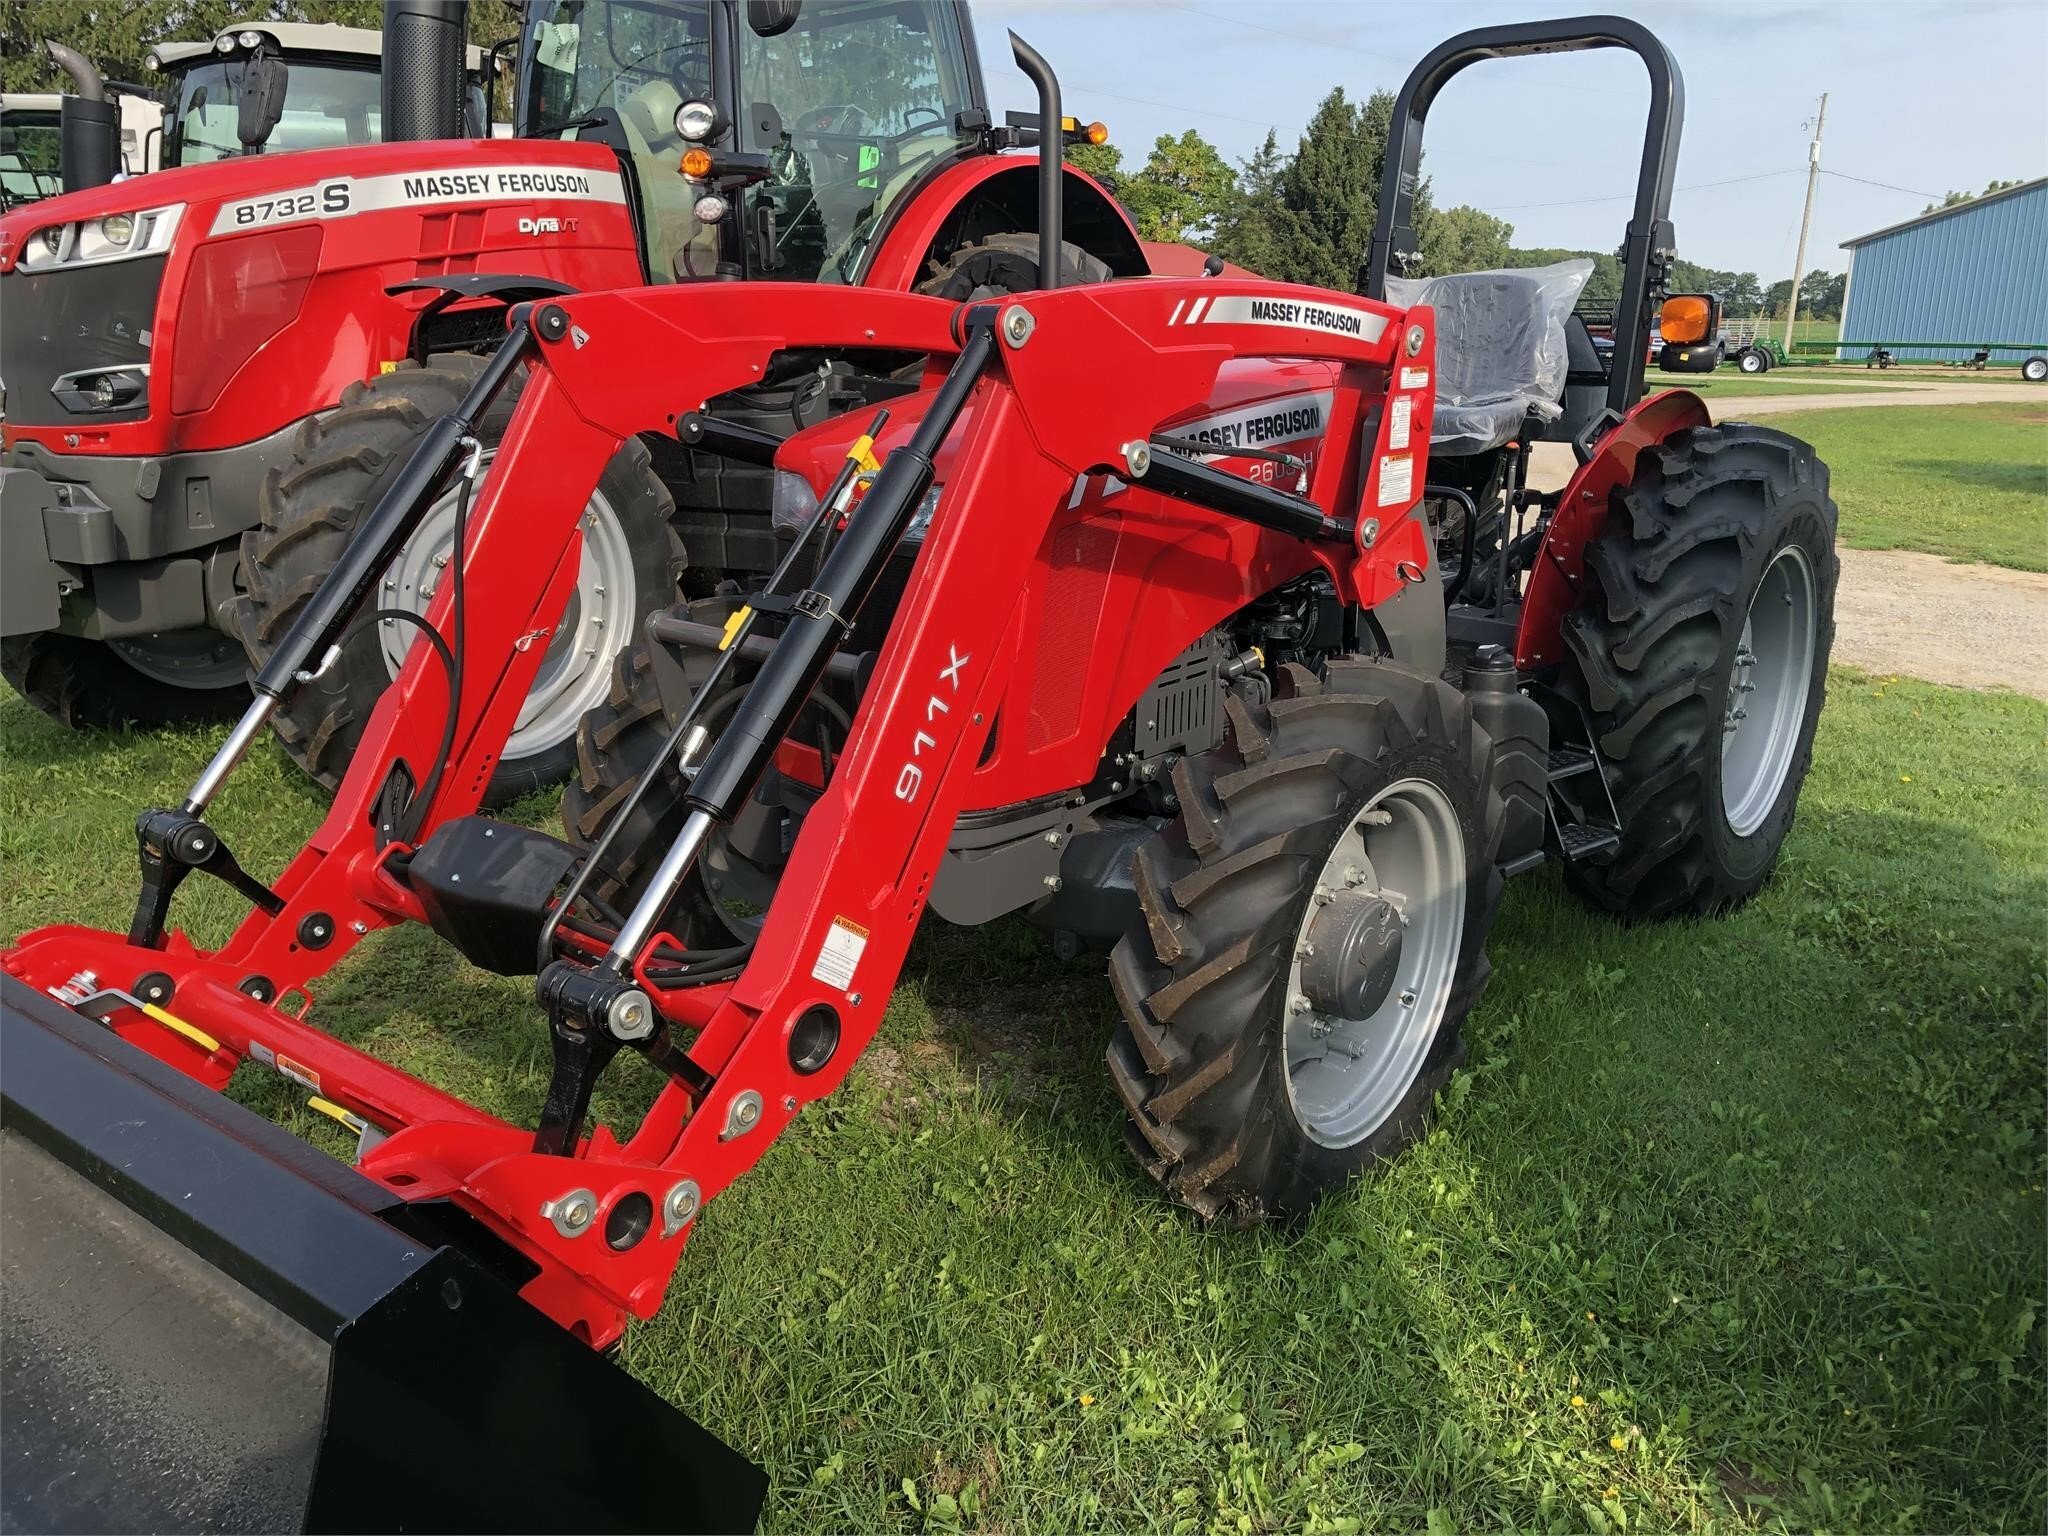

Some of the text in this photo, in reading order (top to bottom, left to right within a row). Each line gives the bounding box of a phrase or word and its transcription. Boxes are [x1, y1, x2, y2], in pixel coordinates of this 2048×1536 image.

[403, 174, 590, 199] MASSEY FERGUSON
[235, 184, 350, 225] 8732 S
[1251, 301, 1361, 335] MASSEY FERGUSON
[1247, 407, 1321, 444] FERGUSON
[842, 920, 869, 938] WARNING
